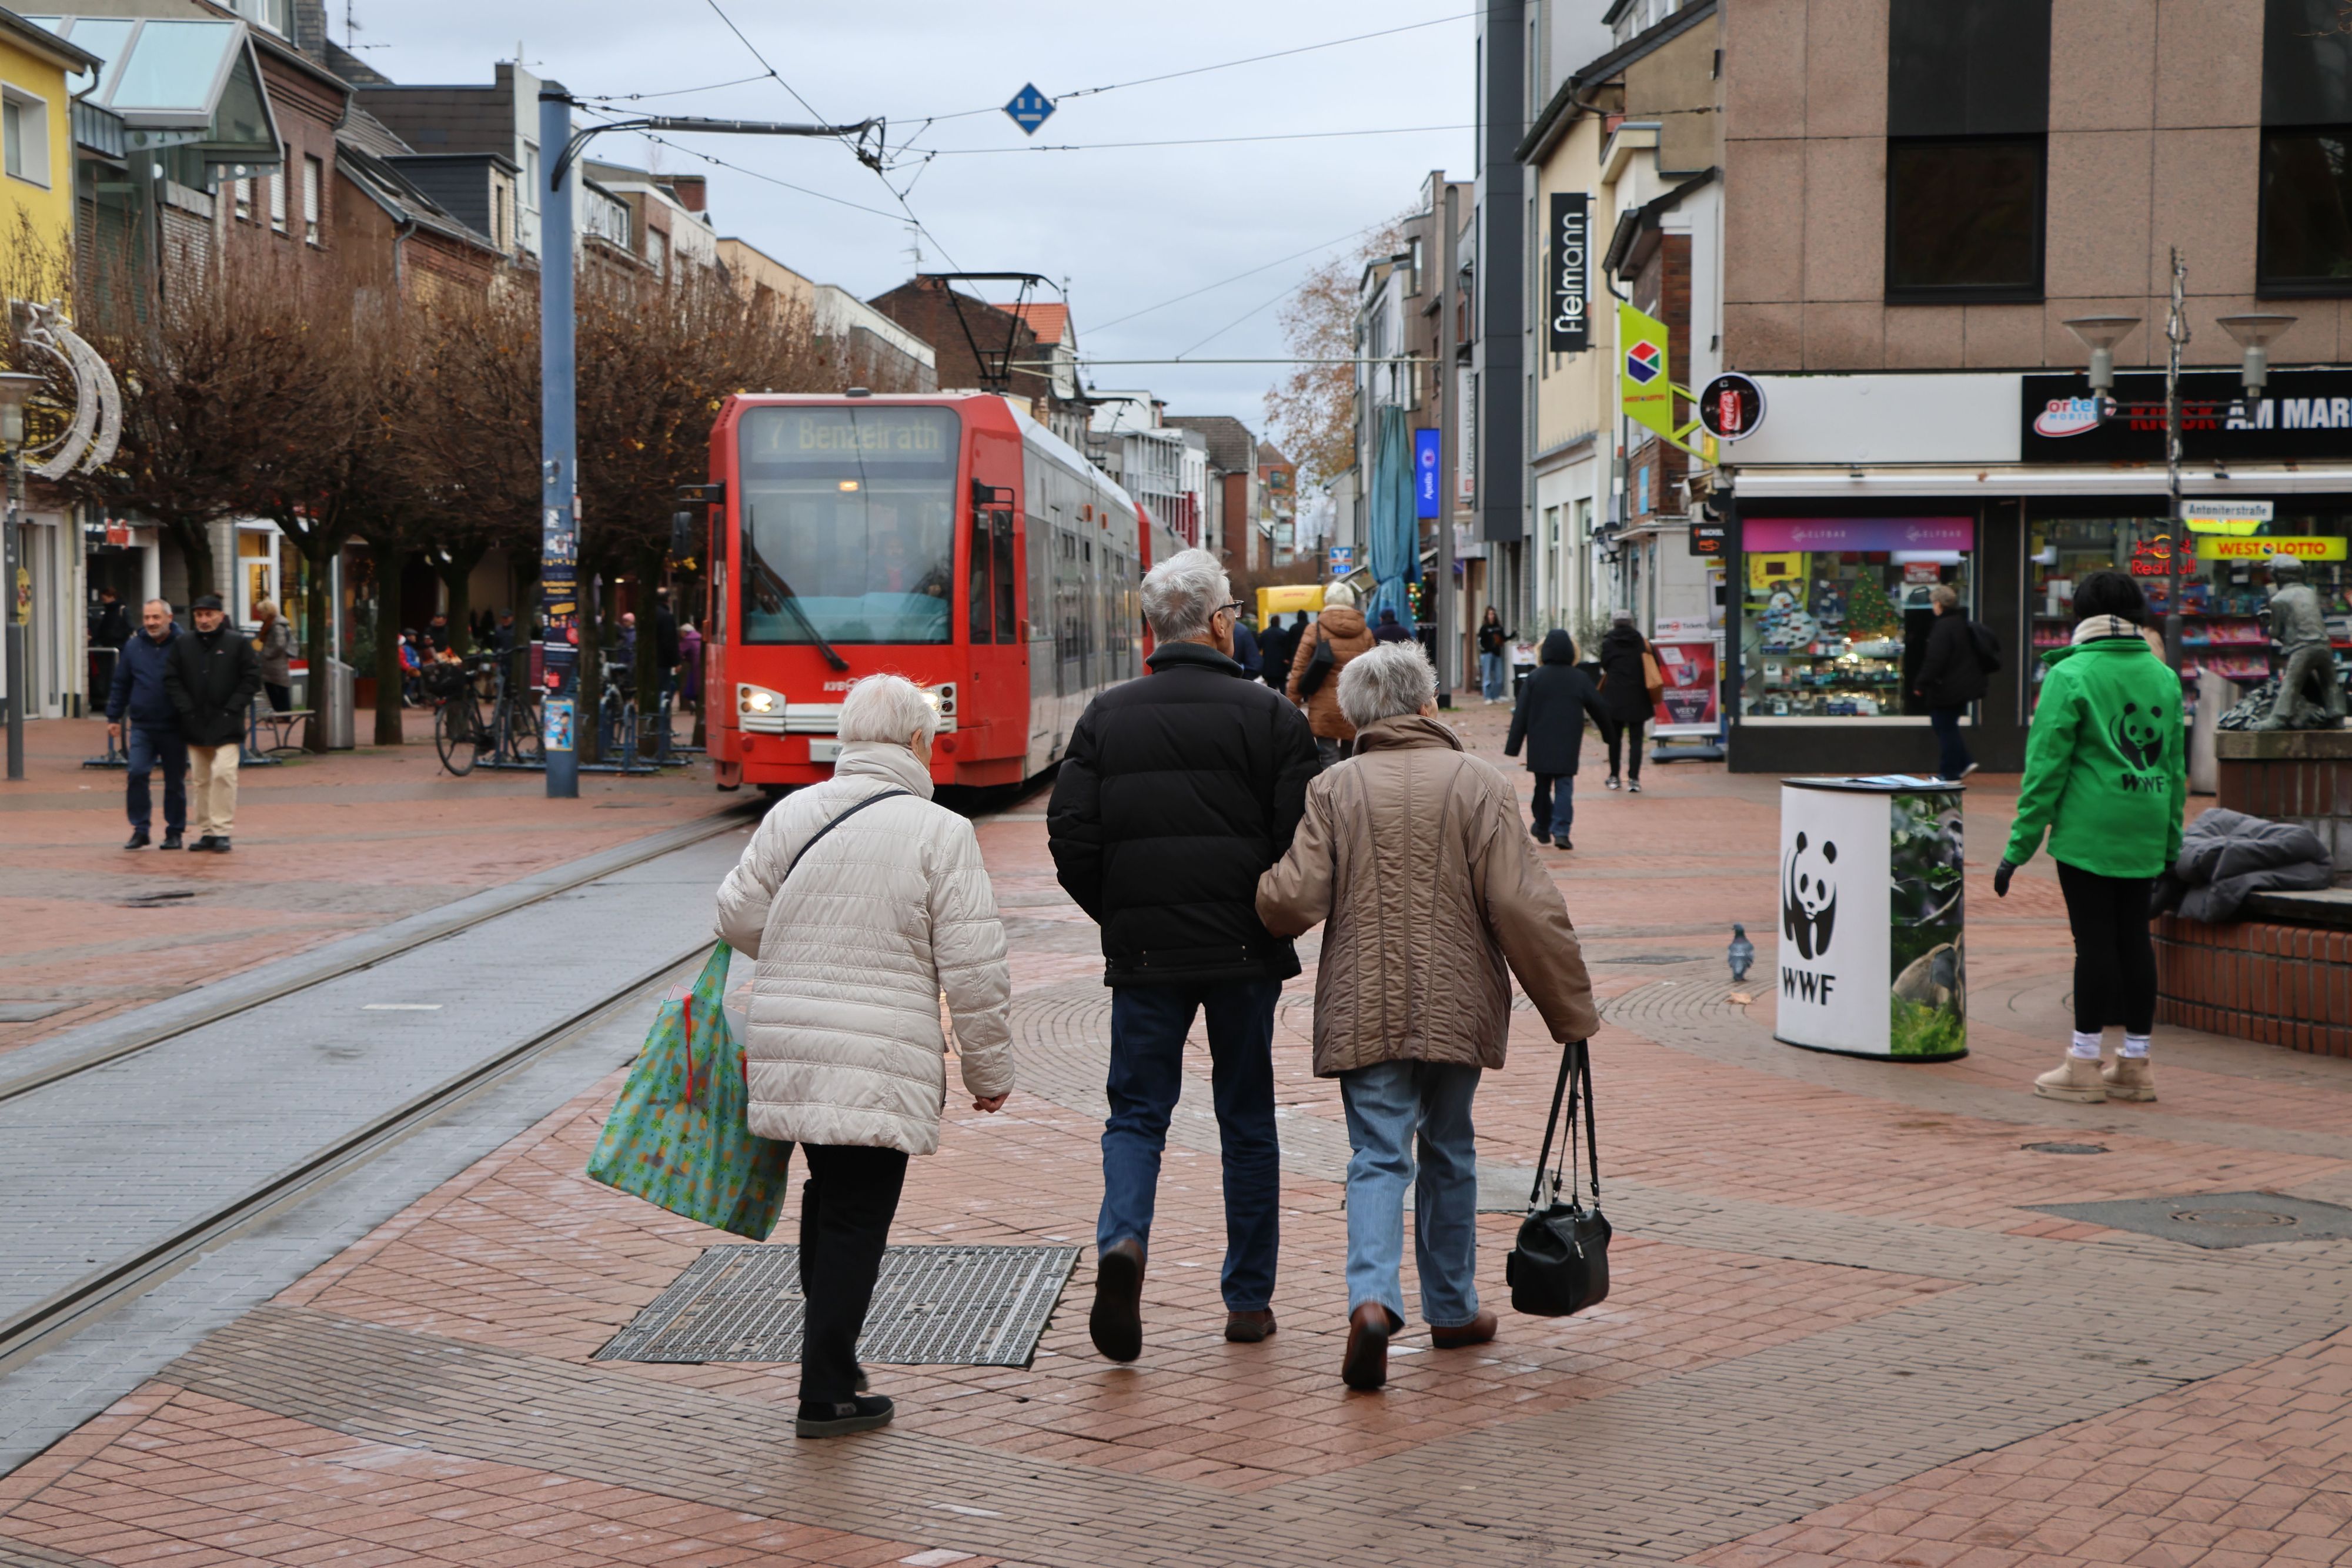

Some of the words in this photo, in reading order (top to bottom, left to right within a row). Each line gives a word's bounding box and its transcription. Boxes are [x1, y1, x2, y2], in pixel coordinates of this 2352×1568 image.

[1554, 212, 1583, 332] fielmann
[2047, 396, 2099, 412] ortel
[2282, 397, 2352, 428] MAR
[768, 417, 783, 449] 7
[1423, 472, 1434, 500] Apollo
[2189, 504, 2267, 516] Antoniterstraße
[2217, 542, 2260, 555] WEST
[2276, 542, 2327, 555] LOTTO
[2122, 773, 2164, 793] WWF
[1782, 966, 1836, 1006] WWF
